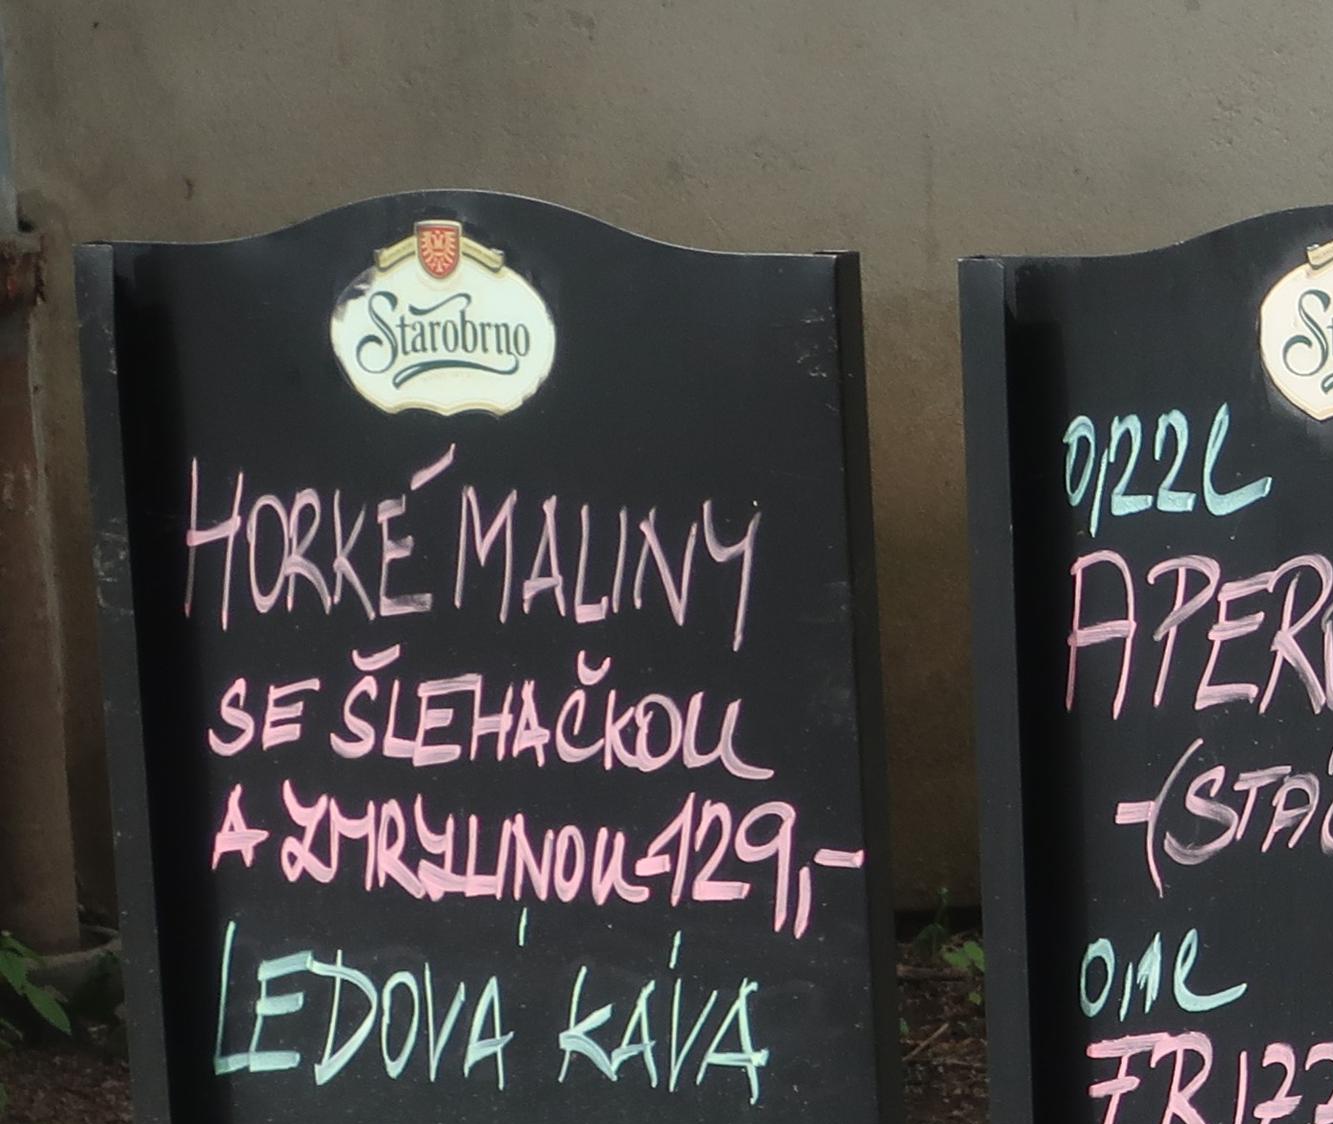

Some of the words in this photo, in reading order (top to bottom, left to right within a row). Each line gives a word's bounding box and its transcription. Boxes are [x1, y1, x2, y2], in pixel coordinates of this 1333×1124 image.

[356, 290, 530, 388] Starobrno
[184, 443, 455, 630] HORKÉ
[455, 485, 762, 652] MALINY
[208, 677, 321, 756] SE
[329, 645, 775, 780] ŠLEHAČKOU
[211, 782, 268, 870] A
[559, 931, 768, 1104] KÁVA
